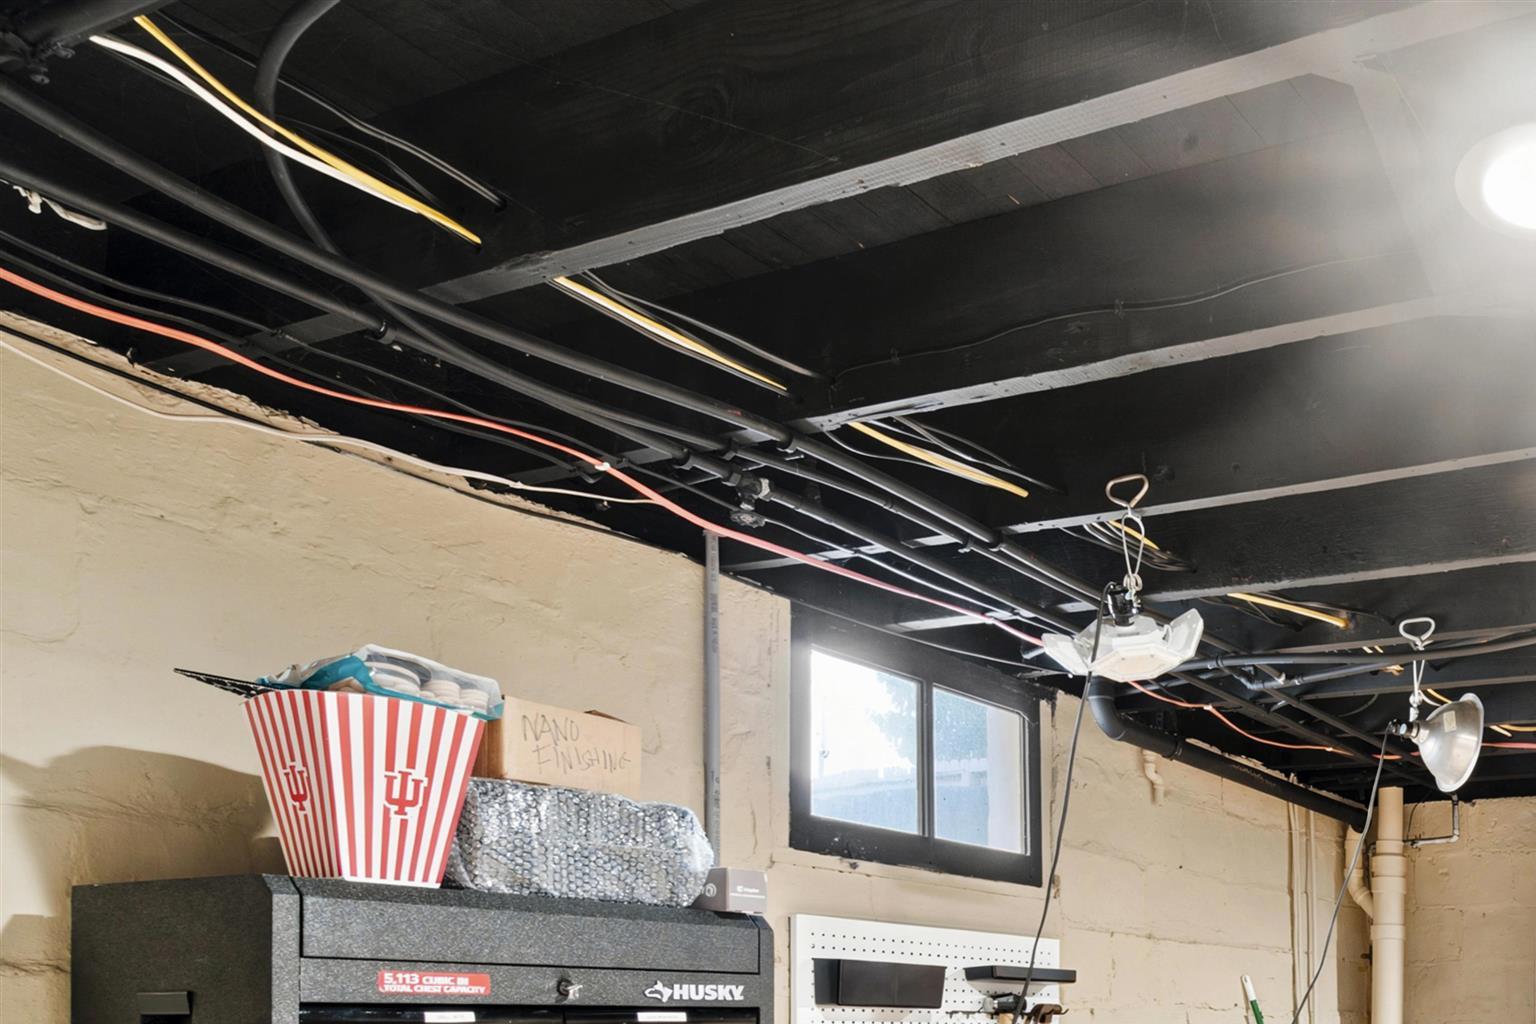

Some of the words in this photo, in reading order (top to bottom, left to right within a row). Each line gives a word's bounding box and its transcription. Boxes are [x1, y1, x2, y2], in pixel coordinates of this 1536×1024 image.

[521, 712, 580, 746] NANO
[532, 744, 633, 775] FINISHING
[673, 983, 744, 1001] HUSKY
